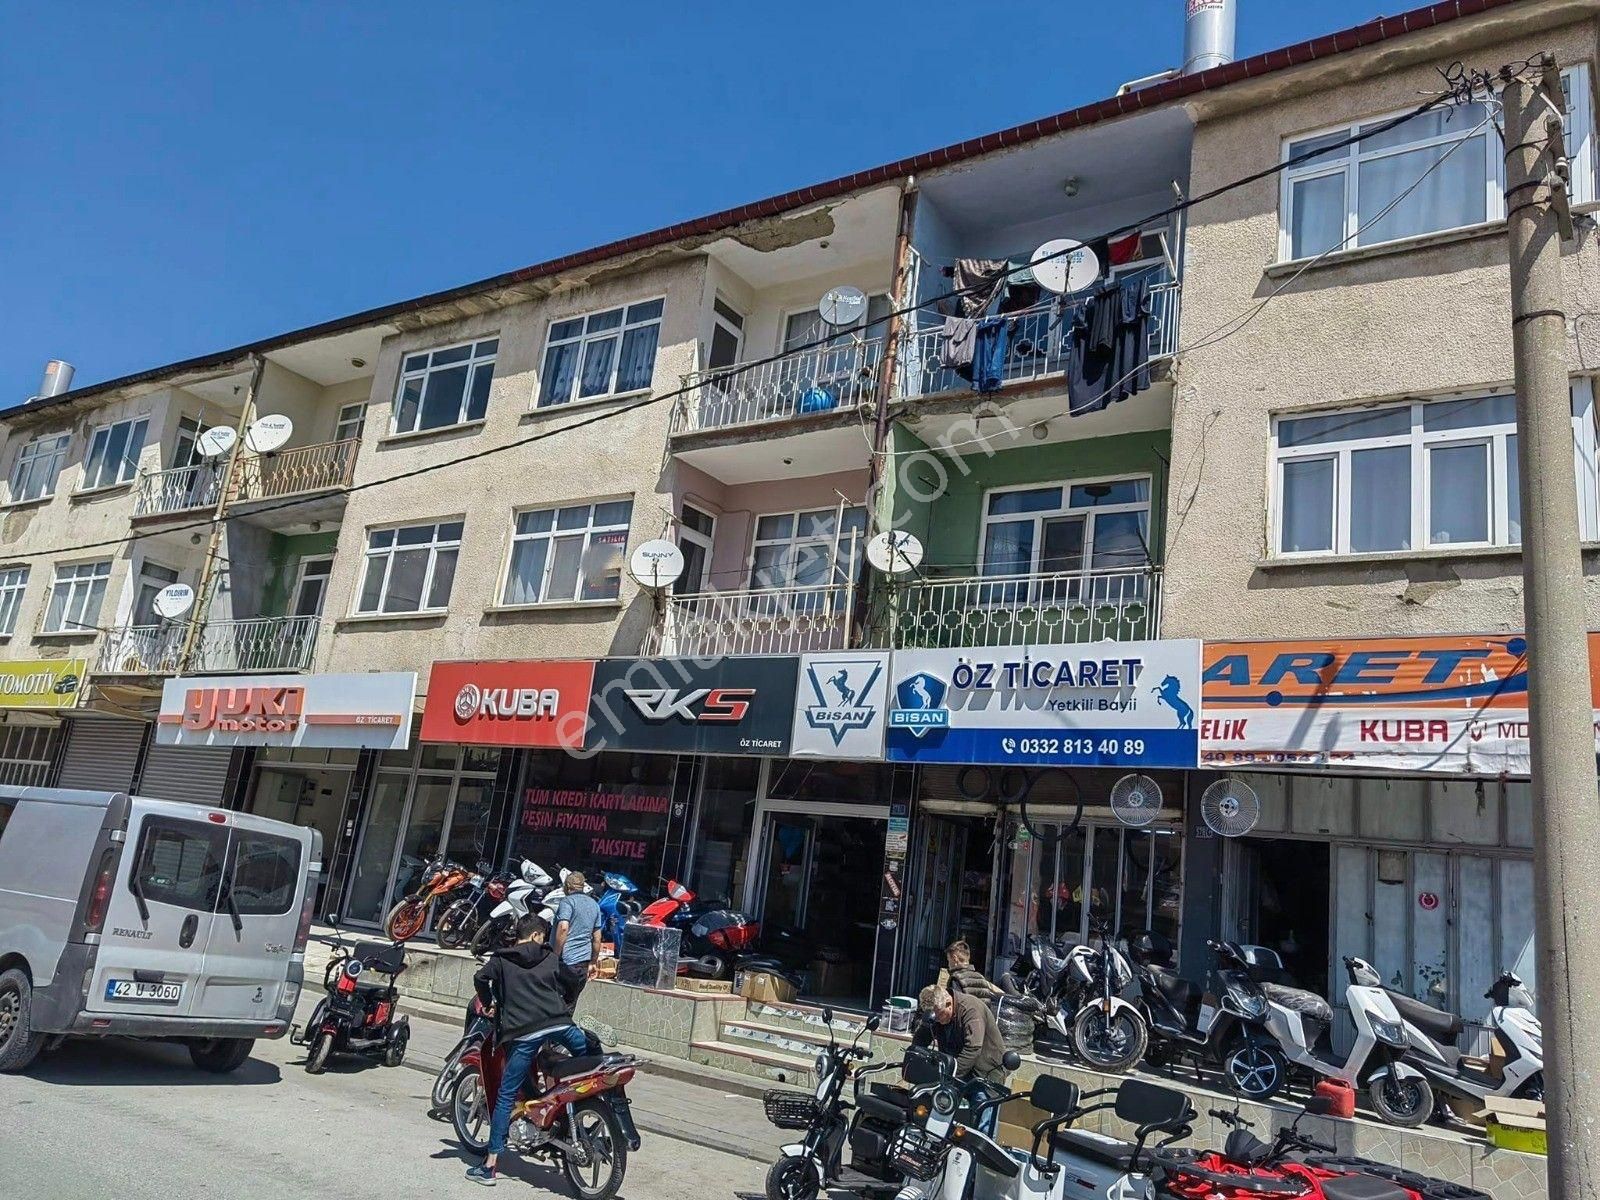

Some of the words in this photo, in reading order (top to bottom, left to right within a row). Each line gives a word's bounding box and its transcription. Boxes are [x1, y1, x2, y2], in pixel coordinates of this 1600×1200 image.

[953, 657, 994, 689] ÖZ
[1003, 656, 1141, 688] TİCARET
[480, 688, 559, 717] KUBA
[624, 688, 756, 720] RKS
[1050, 699, 1093, 711] Yetkili
[1099, 698, 1137, 713] Bayii
[1361, 719, 1448, 742] KUBA
[740, 738, 750, 747] ÖZ
[752, 738, 782, 748] TİCARET
[1021, 739, 1059, 753] 0332
[1064, 739, 1092, 753] 813
[1098, 740, 1118, 754] 40
[1124, 740, 1144, 754] 89
[112, 927, 152, 940] RENAULT
[115, 983, 129, 996] 42
[136, 985, 144, 996] U
[149, 985, 178, 999] 3060
